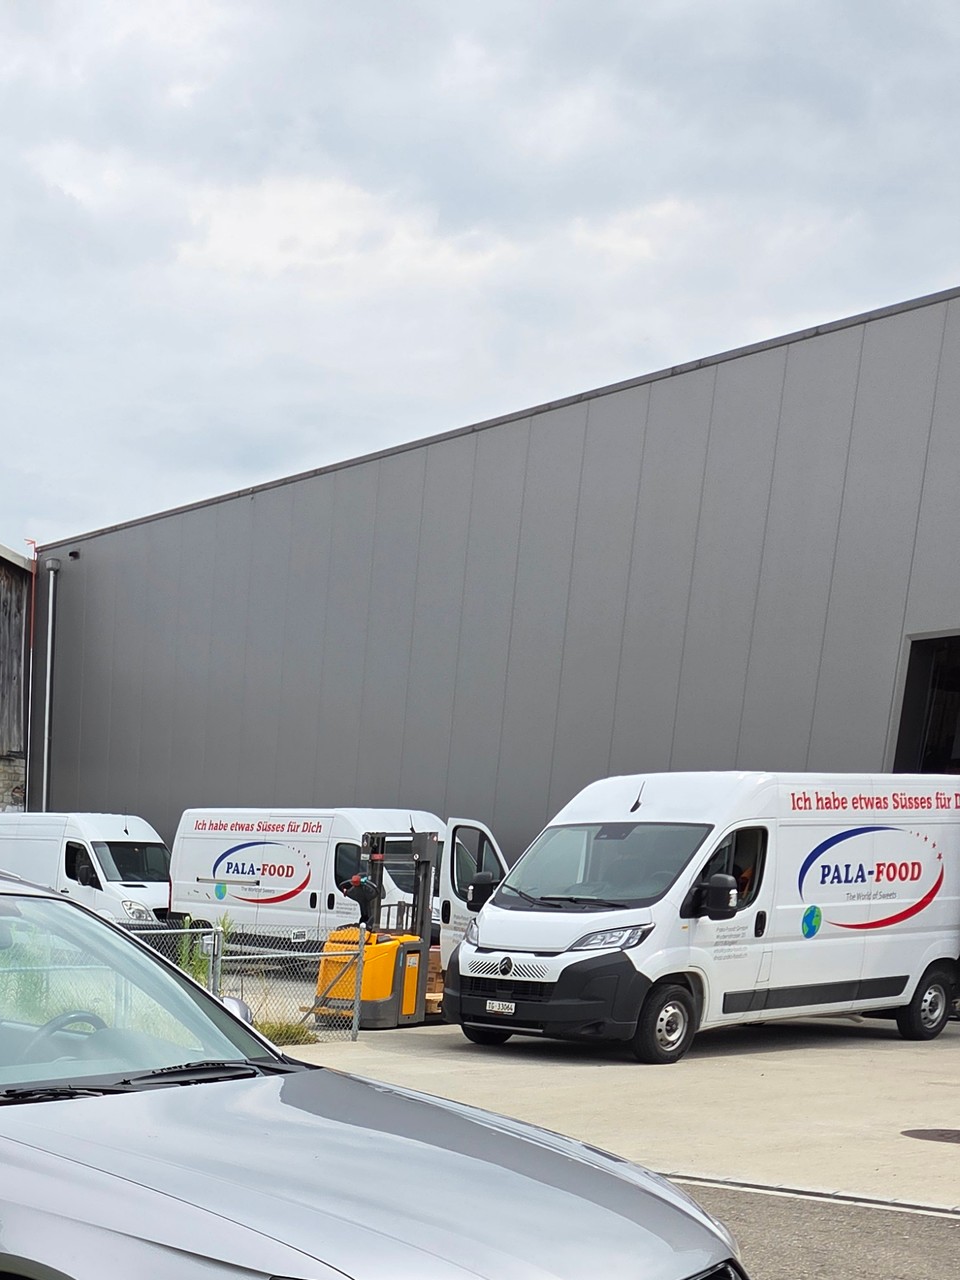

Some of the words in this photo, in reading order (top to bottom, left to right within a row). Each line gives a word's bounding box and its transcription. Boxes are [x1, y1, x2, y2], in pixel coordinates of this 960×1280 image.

[791, 792, 812, 811] Ich
[815, 792, 848, 811] habe
[851, 793, 889, 811] etwas
[892, 792, 932, 810] Süsses
[935, 792, 952, 810] für
[194, 820, 207, 831] Ich
[208, 820, 228, 832] habe
[229, 822, 254, 833] etwas
[256, 821, 285, 833] Süsses
[287, 820, 300, 834] für
[300, 821, 323, 834] Dich
[225, 861, 295, 879] PALA-FOOD
[820, 861, 922, 885] PALA-FOOD
[846, 892, 855, 901] The
[856, 892, 872, 900] World
[872, 891, 879, 900] of
[879, 891, 897, 900] Sweets
